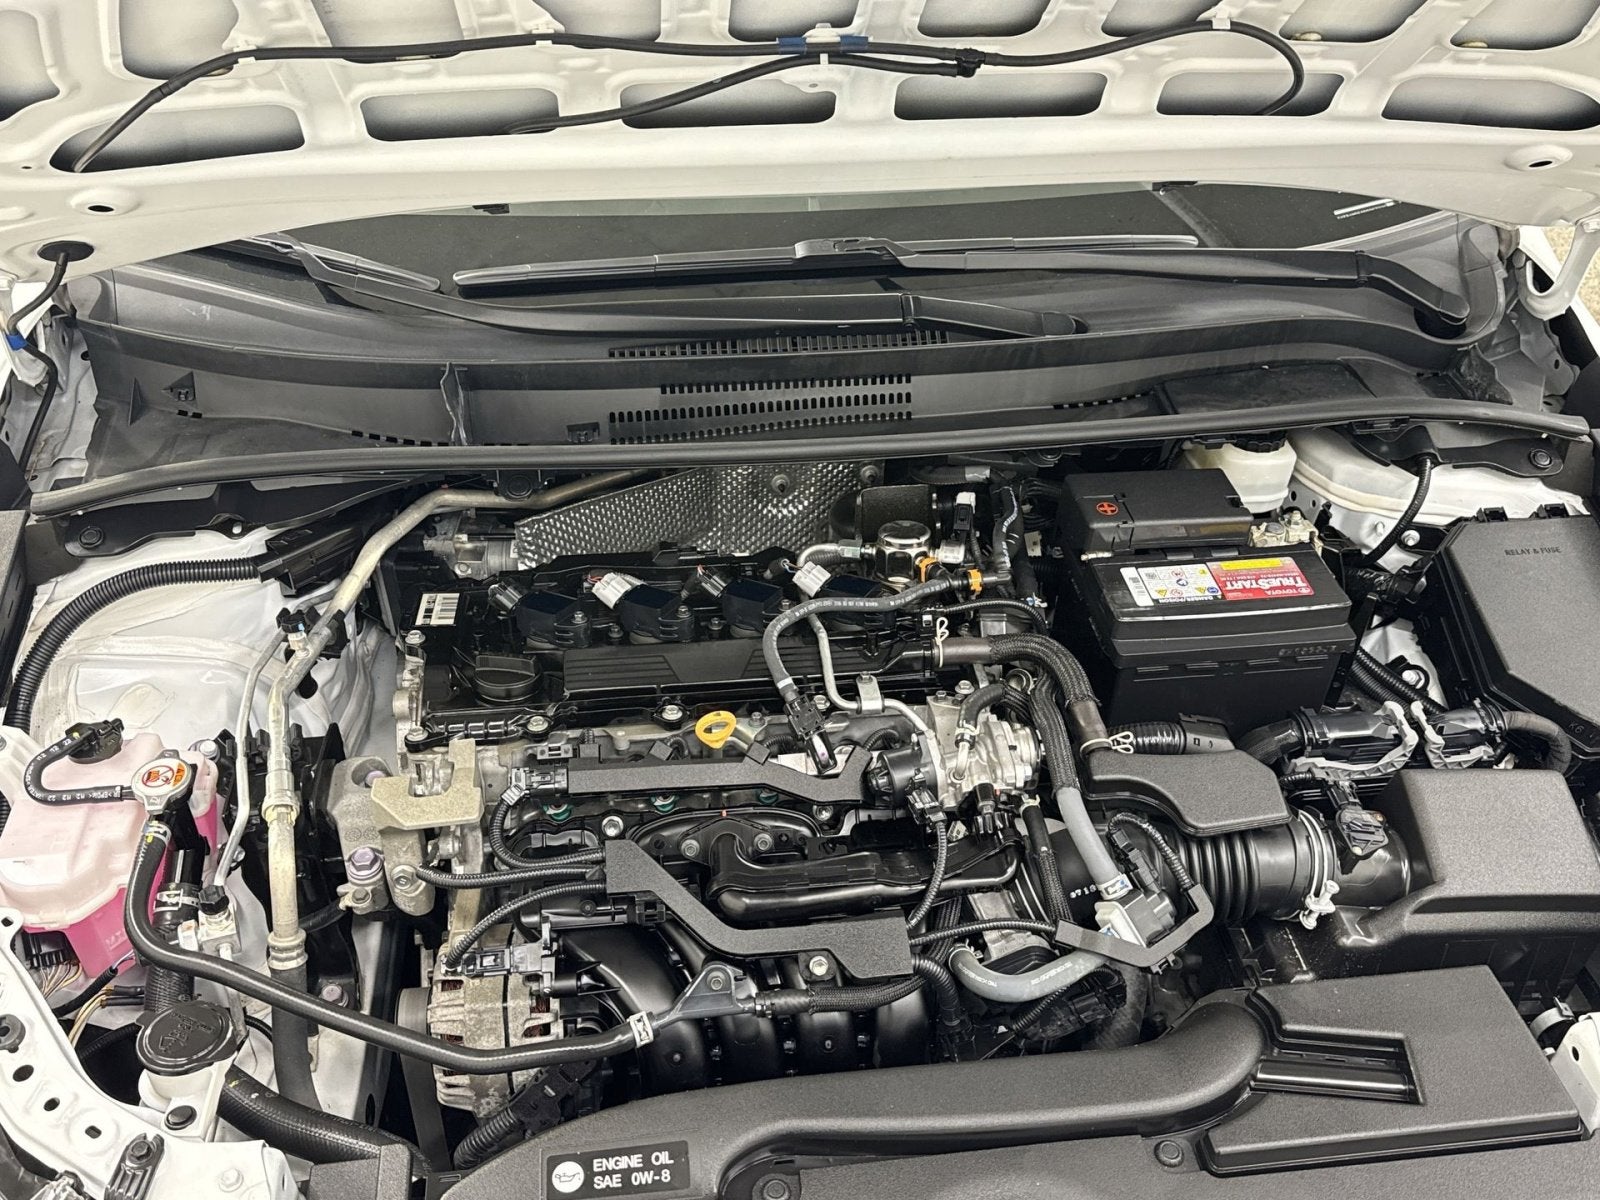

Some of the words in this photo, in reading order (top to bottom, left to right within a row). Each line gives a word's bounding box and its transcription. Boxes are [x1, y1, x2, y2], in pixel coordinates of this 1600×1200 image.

[1504, 548, 1530, 556] RELAY
[1540, 546, 1561, 554] FUSE
[1265, 588, 1298, 596] TOYOTA
[593, 1154, 643, 1172] ENGINE
[651, 1151, 674, 1165] OIL
[593, 1174, 623, 1190] SAE
[631, 1169, 671, 1185] 0W-8
